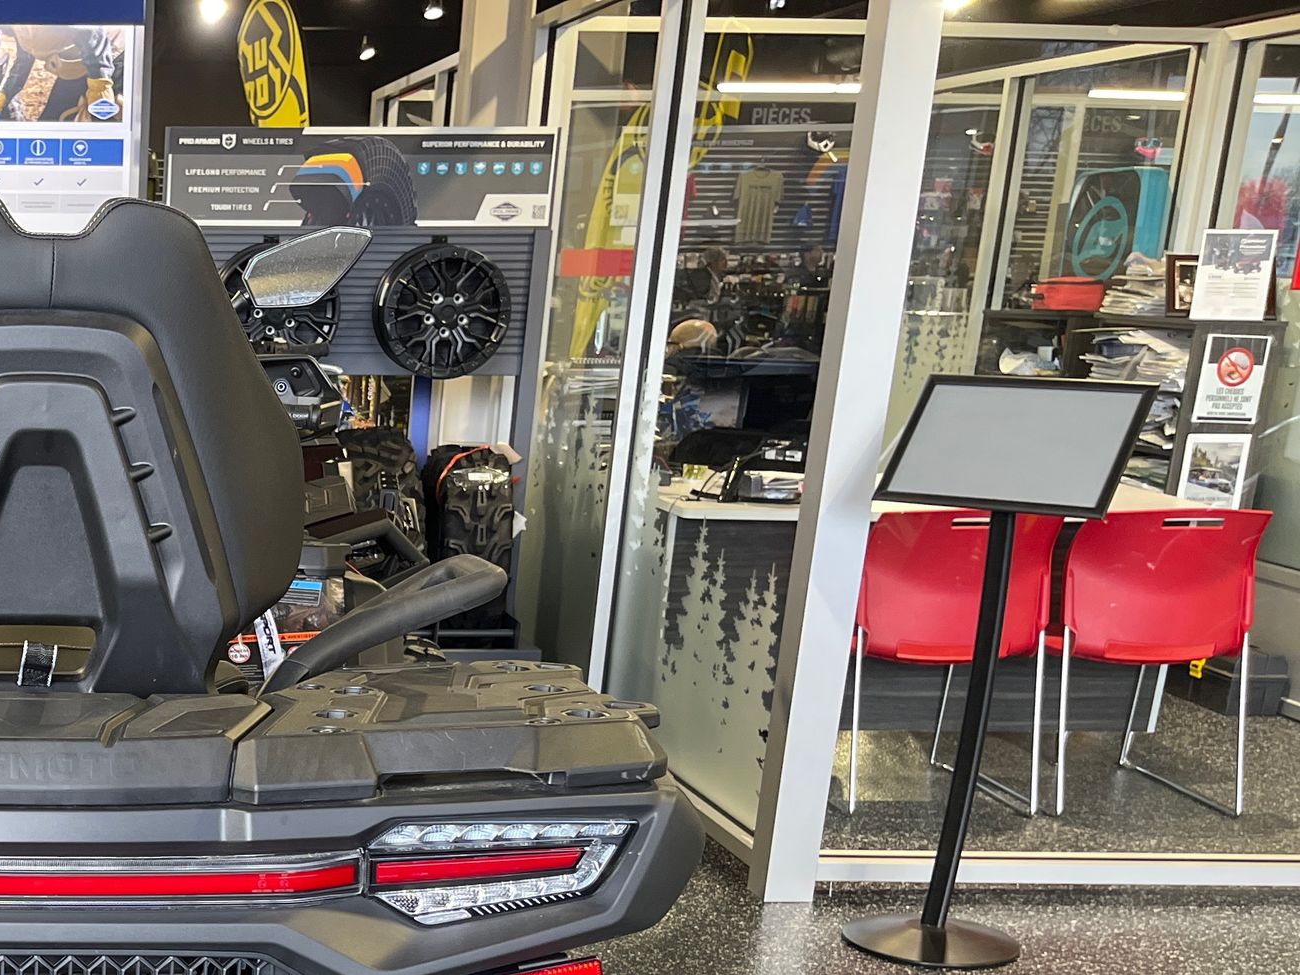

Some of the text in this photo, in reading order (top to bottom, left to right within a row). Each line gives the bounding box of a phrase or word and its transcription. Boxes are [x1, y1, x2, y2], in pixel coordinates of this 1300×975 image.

[751, 103, 812, 125] PIÈCES
[242, 137, 294, 146] WHEELS & TIRES
[422, 140, 453, 148] SUPERIOR
[453, 140, 500, 148] PERFORMANCE
[506, 140, 546, 148] DURABILITY
[185, 168, 267, 177] LIFELONG PERFORMANCE
[188, 186, 260, 195] PREMIUM PROTECTION
[210, 203, 232, 211] TOUGH
